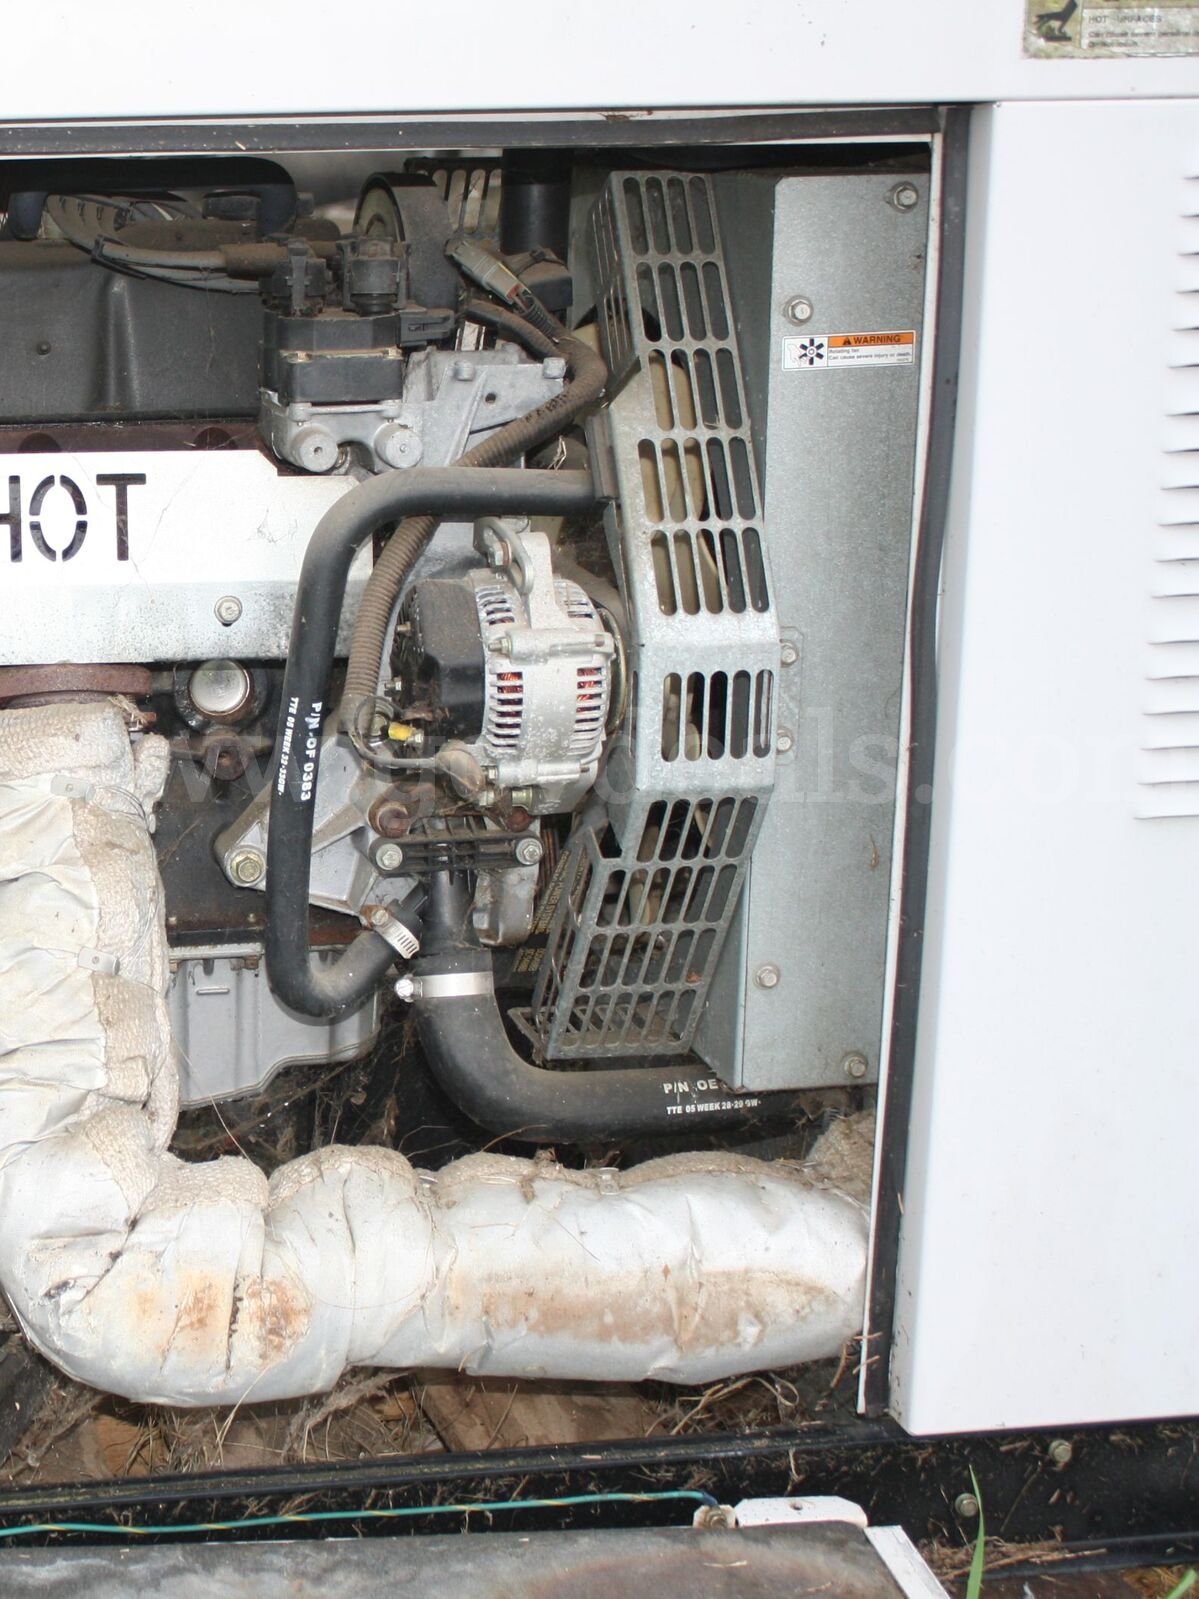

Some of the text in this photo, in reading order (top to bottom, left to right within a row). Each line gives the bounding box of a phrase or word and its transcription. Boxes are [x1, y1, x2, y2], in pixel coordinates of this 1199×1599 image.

[853, 335, 901, 345] WARNING
[288, 697, 299, 714] TTE
[282, 728, 293, 754] WEEK
[300, 762, 314, 801] 0383
[663, 1080, 690, 1094] P/N
[666, 1105, 683, 1115] TTE
[685, 1103, 696, 1113] 05
[697, 1101, 721, 1112] WEEK
